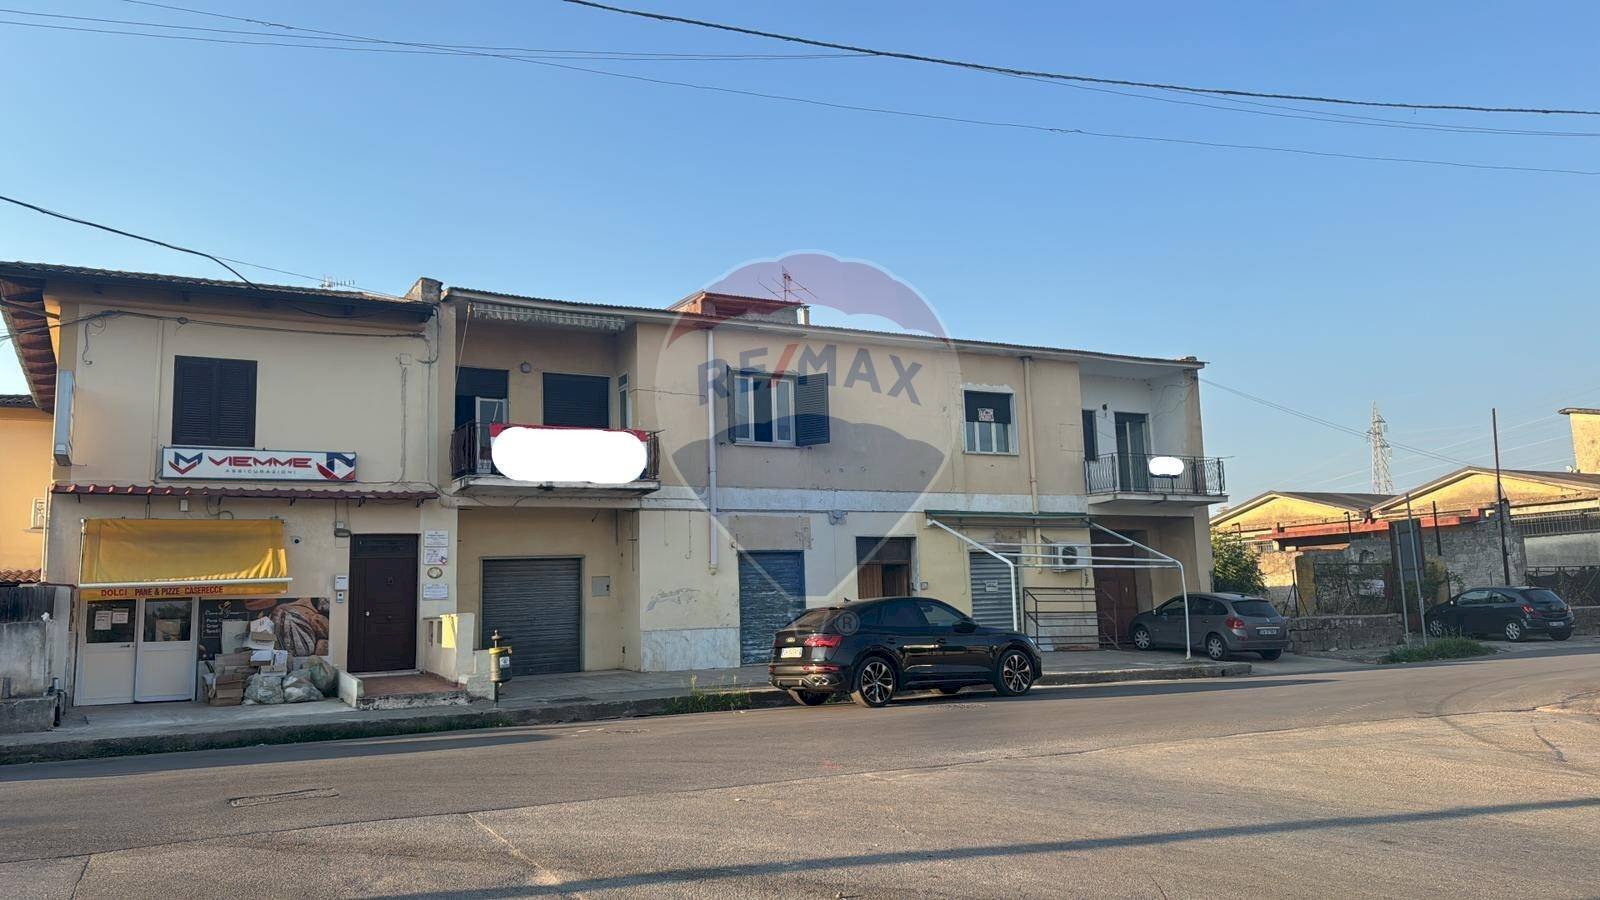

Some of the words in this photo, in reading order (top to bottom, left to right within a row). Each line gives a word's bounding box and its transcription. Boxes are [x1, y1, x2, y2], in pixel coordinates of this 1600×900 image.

[208, 455, 312, 469] VIEMME
[101, 589, 128, 597] DOLCI
[135, 588, 153, 597] PANE
[154, 587, 160, 596] &
[161, 587, 180, 596] PIZZE
[184, 585, 224, 595] CASERECCE
